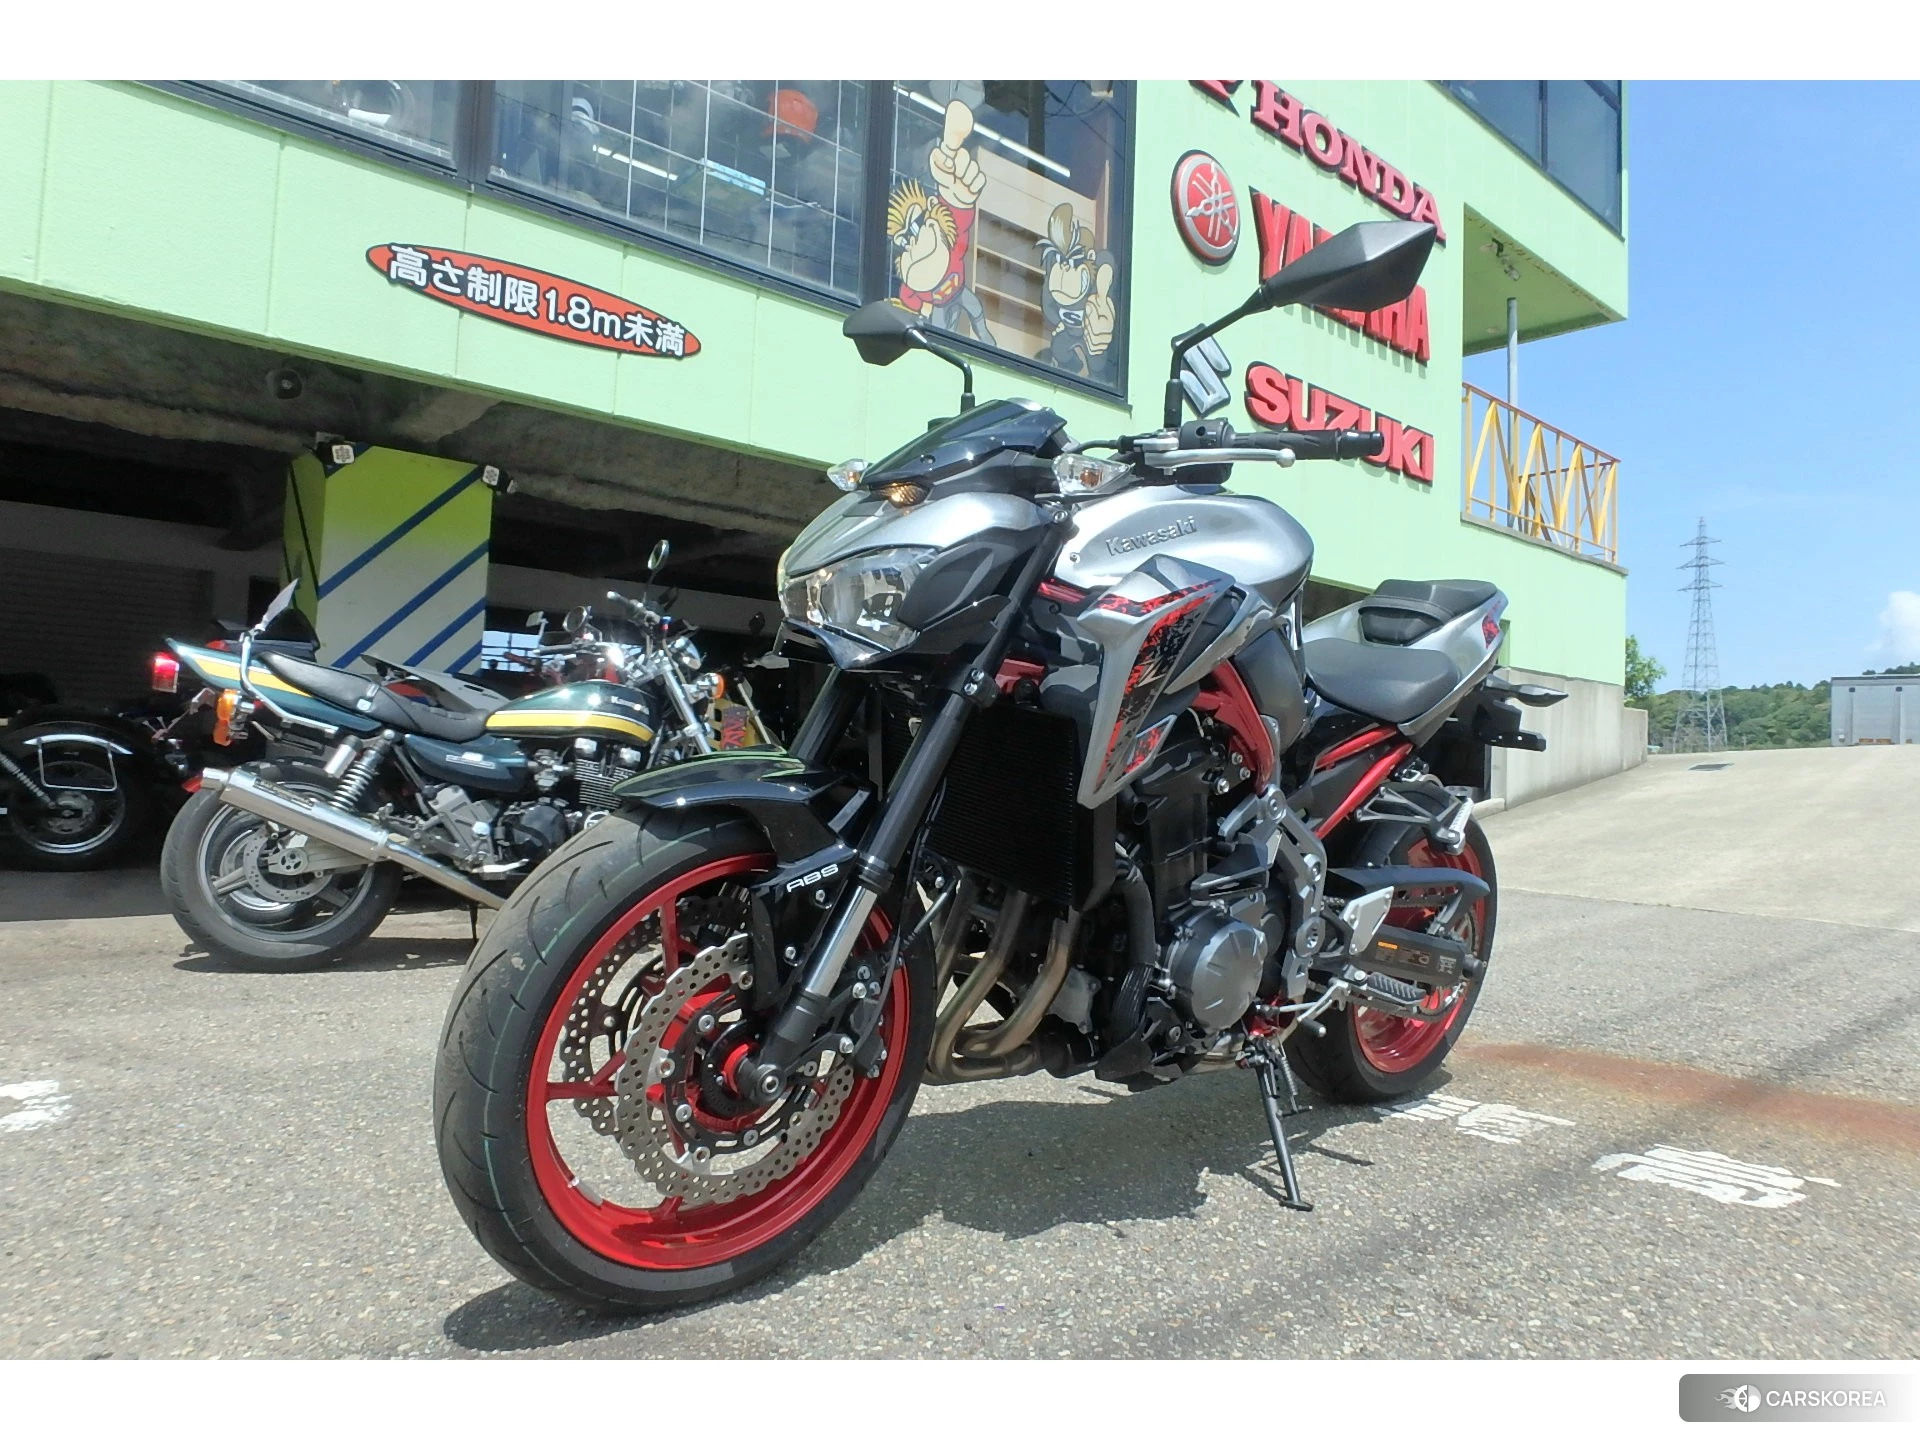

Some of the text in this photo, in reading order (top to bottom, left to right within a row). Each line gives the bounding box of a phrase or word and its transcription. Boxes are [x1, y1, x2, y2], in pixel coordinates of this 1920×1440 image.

[1251, 80, 1446, 246] HONDA
[388, 243, 688, 358] 高さ制限1.8m未満
[1245, 362, 1435, 484] SUZUKI
[1105, 515, 1198, 557] Kawasaki
[786, 863, 839, 893] ABS
